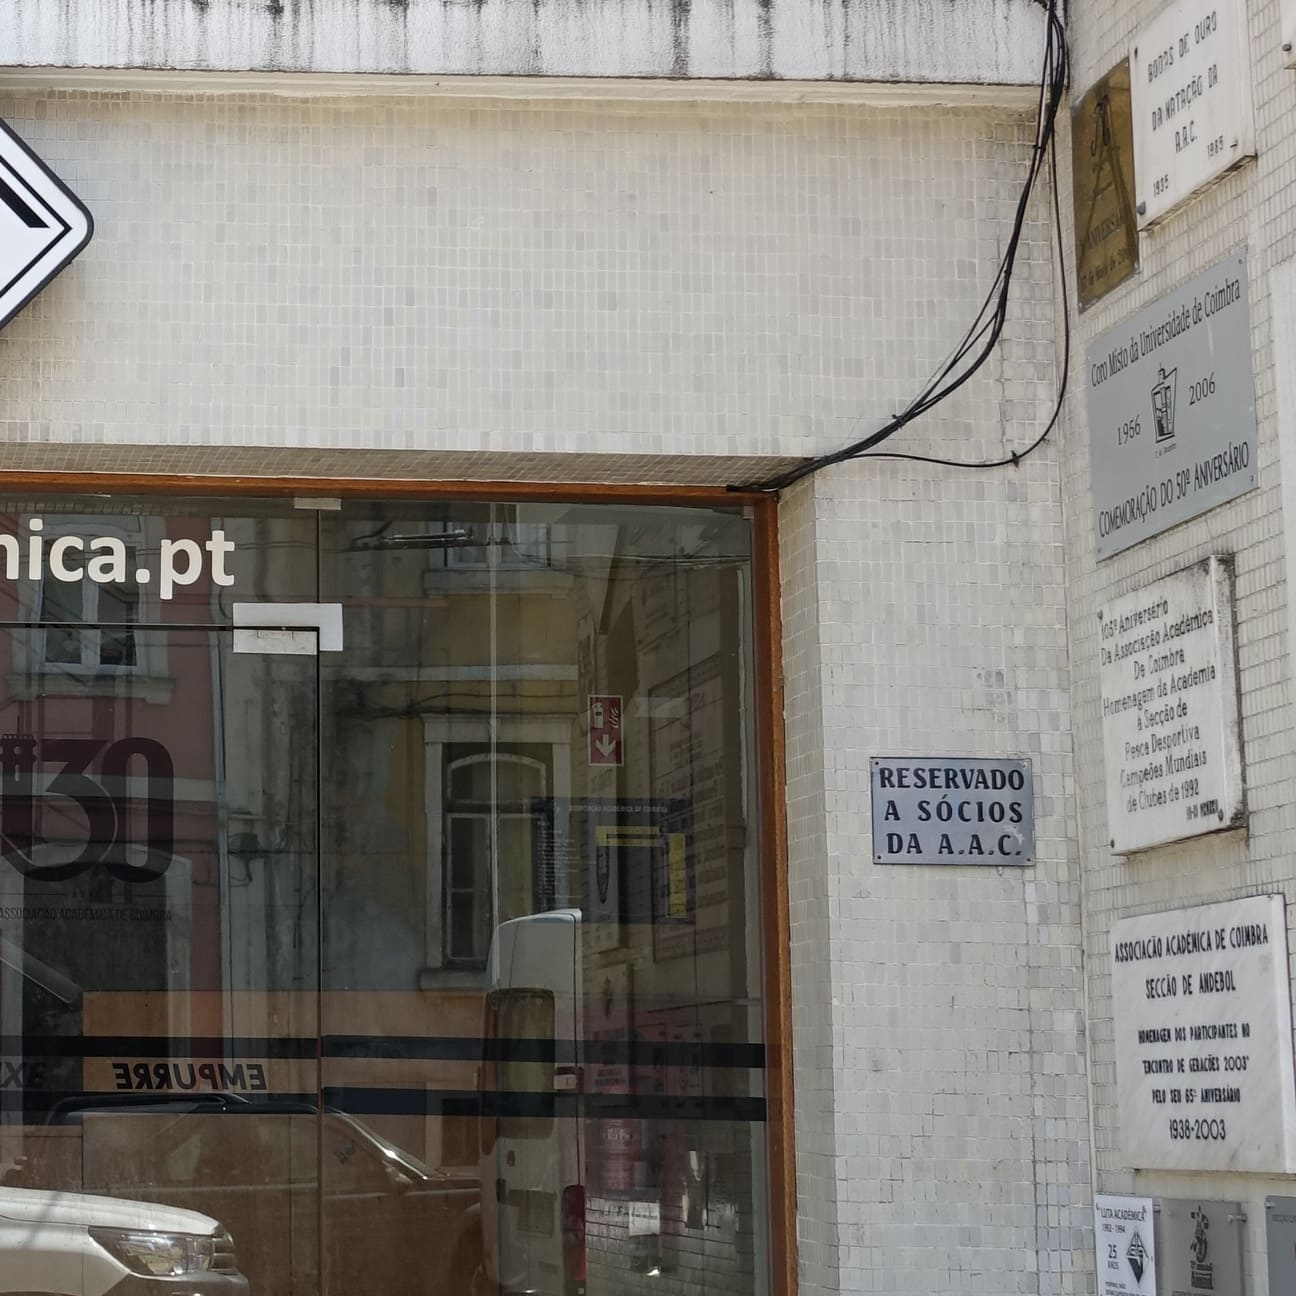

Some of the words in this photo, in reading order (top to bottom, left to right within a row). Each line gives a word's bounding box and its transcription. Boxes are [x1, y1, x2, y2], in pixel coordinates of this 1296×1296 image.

[1147, 46, 1174, 83] BODAS
[1178, 33, 1191, 58] DE
[1194, 10, 1218, 44] OURO
[1152, 107, 1163, 132] DA
[1208, 63, 1219, 90] DA
[1207, 135, 1224, 158] 1985
[1091, 362, 1108, 388] Coro
[1108, 347, 1128, 377] Misto
[1130, 337, 1140, 364] da
[1140, 305, 1191, 357] Universidade
[1192, 297, 1203, 323] de
[1204, 278, 1241, 318] Coimbra
[1189, 371, 1216, 406] 2006
[1099, 485, 1157, 538] COMEMORAÇÃO
[1160, 478, 1174, 508] DO
[1176, 467, 1192, 500] 50º
[1194, 441, 1250, 492] ANIVERSÁRIO
[1101, 646, 1112, 666] Da
[1113, 630, 1161, 662] Associação
[1133, 659, 1145, 681] De
[1148, 647, 1185, 676] Coimbra
[1103, 686, 1155, 717] Homenagem
[1157, 679, 1168, 699] da
[1169, 664, 1216, 693] Academia
[1144, 703, 1175, 731] Secção
[1177, 697, 1188, 718] de
[1124, 738, 1150, 761] Pesca
[1151, 724, 1200, 754] Desportiva
[879, 767, 1025, 791] RESERVADO
[1120, 759, 1163, 788] Campeões
[1164, 749, 1207, 778] Mundiais
[884, 800, 901, 821] A
[917, 794, 1023, 823] SÓCIOS
[1127, 793, 1138, 813] de
[1139, 786, 1167, 811] Clubes
[1168, 782, 1180, 803] de
[1181, 777, 1200, 800] 1992
[886, 833, 923, 854] DA
[938, 833, 1023, 856] A.A.C.
[1165, 929, 1212, 956] ACADÉMICA
[1214, 928, 1226, 950] DE
[1229, 923, 1269, 949] COIMBRA
[1182, 974, 1193, 996] DE
[1199, 970, 1236, 994] ANDEBOL
[1138, 1027, 1171, 1044] HOMENAGEM
[1175, 1026, 1187, 1042] DOS
[1190, 1023, 1238, 1041] PARTICIPANTES
[1241, 1022, 1250, 1039] NO
[1177, 1058, 1185, 1074] DE
[1152, 1088, 1167, 1104] PELO
[1170, 1087, 1182, 1103] SEU
[1200, 1083, 1241, 1104] ANIVERSÁRIO
[1114, 1208, 1145, 1222] ACADÉMICA
[1108, 1244, 1117, 1260] 25
